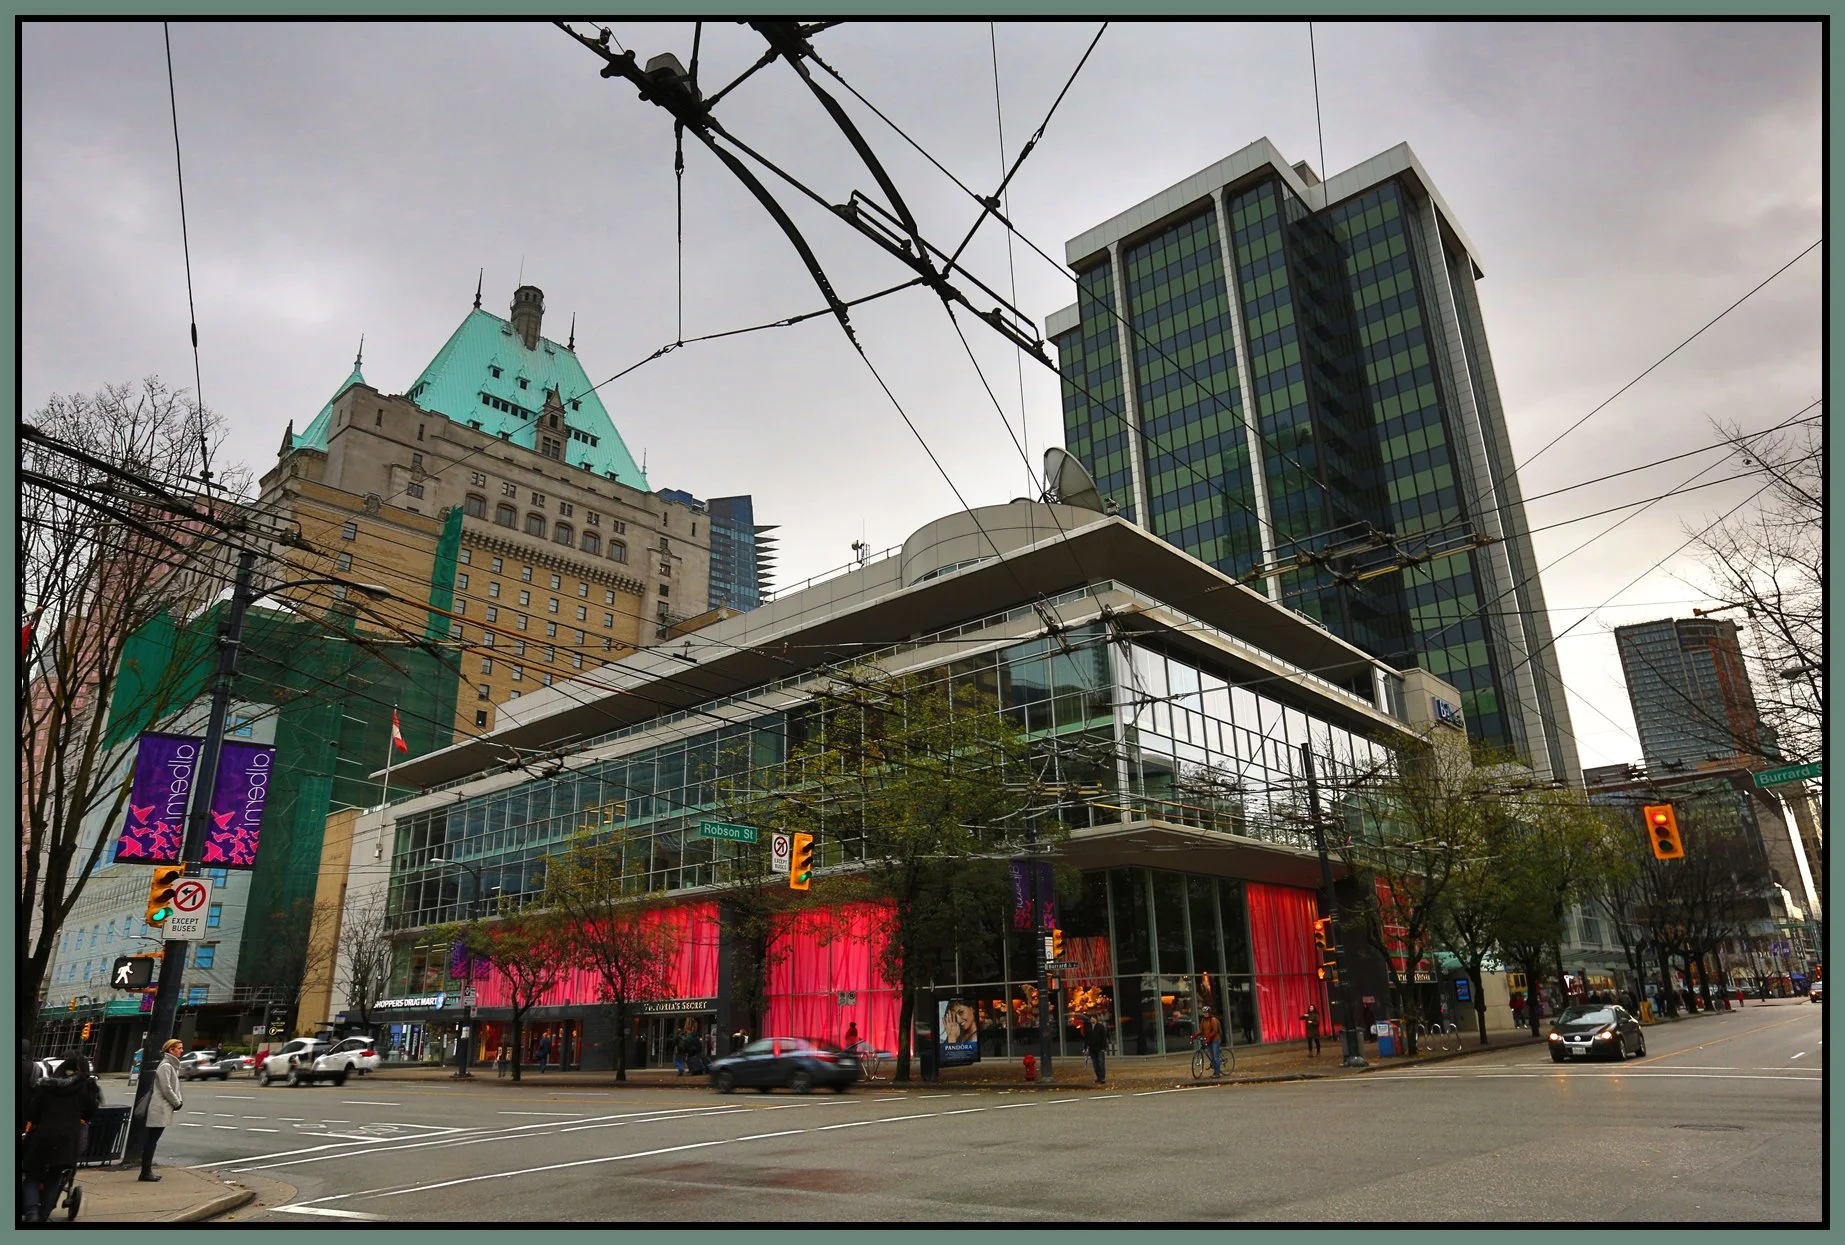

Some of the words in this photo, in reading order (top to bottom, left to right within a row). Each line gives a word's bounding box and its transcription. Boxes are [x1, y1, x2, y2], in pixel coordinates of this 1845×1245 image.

[1759, 767, 1810, 784] Burrard
[704, 823, 740, 838] Robson
[743, 828, 753, 840] St
[171, 917, 199, 925] EXCEPT
[404, 998, 420, 1007] DRUG
[421, 997, 438, 1006] MART
[682, 1001, 708, 1010] SECRET
